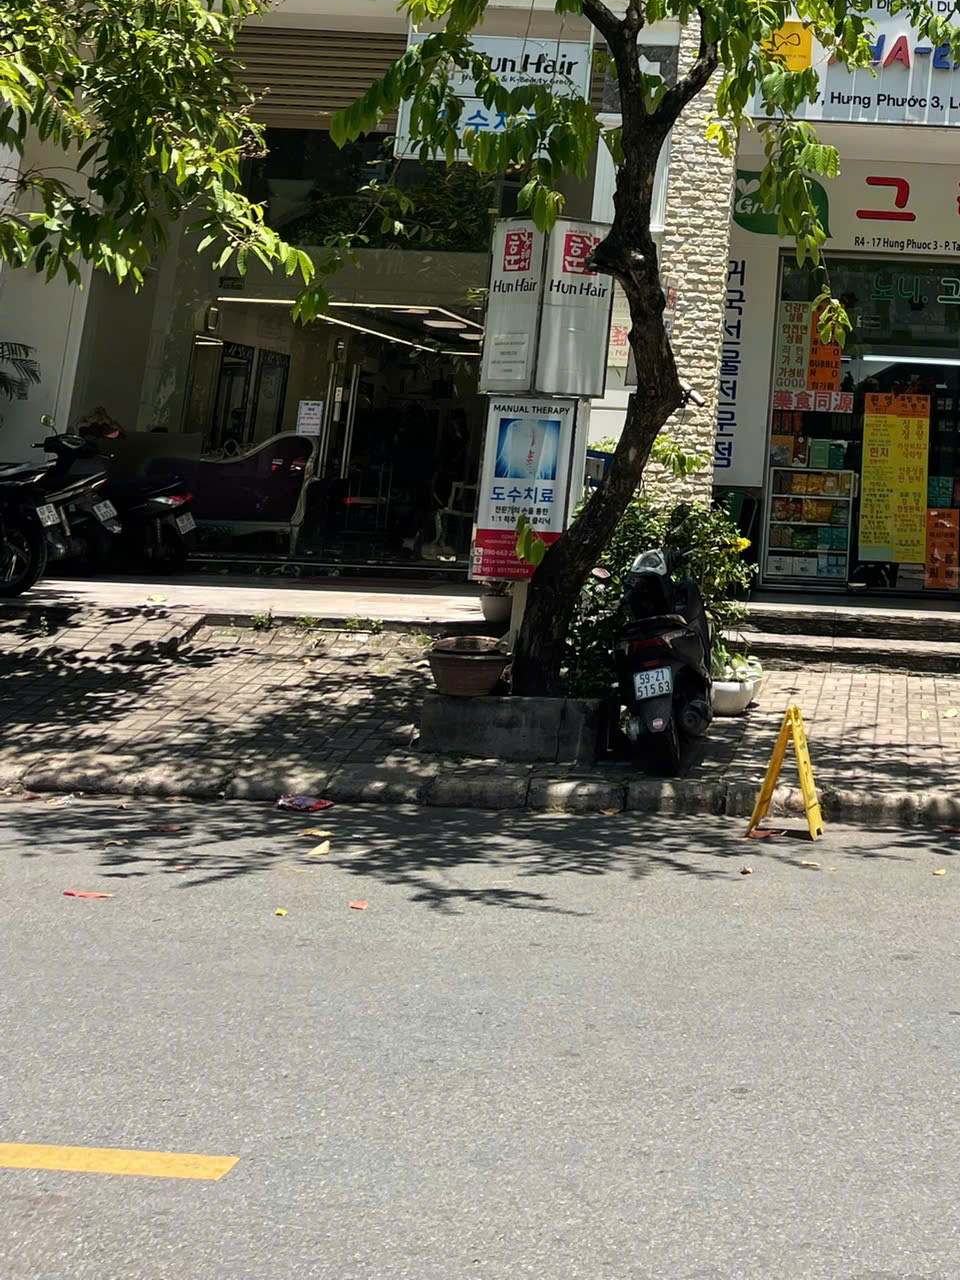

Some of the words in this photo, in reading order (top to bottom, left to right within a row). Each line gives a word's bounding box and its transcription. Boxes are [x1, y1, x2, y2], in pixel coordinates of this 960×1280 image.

[523, 54, 579, 76] Hair
[877, 93, 927, 109] Phước
[931, 96, 944, 111] 3,
[854, 236, 865, 247] R4
[872, 237, 881, 248] 17
[883, 238, 905, 251] Hung
[906, 239, 932, 251] Phuoc
[933, 240, 938, 250] 3
[493, 279, 514, 293] Hun
[515, 277, 538, 293] Hair
[549, 279, 577, 296] Hun
[579, 282, 608, 298] Hair
[776, 378, 805, 388] GOOD
[494, 404, 529, 414] MANUAL
[531, 405, 570, 416] THERAPY
[490, 486, 555, 505] 도수치료
